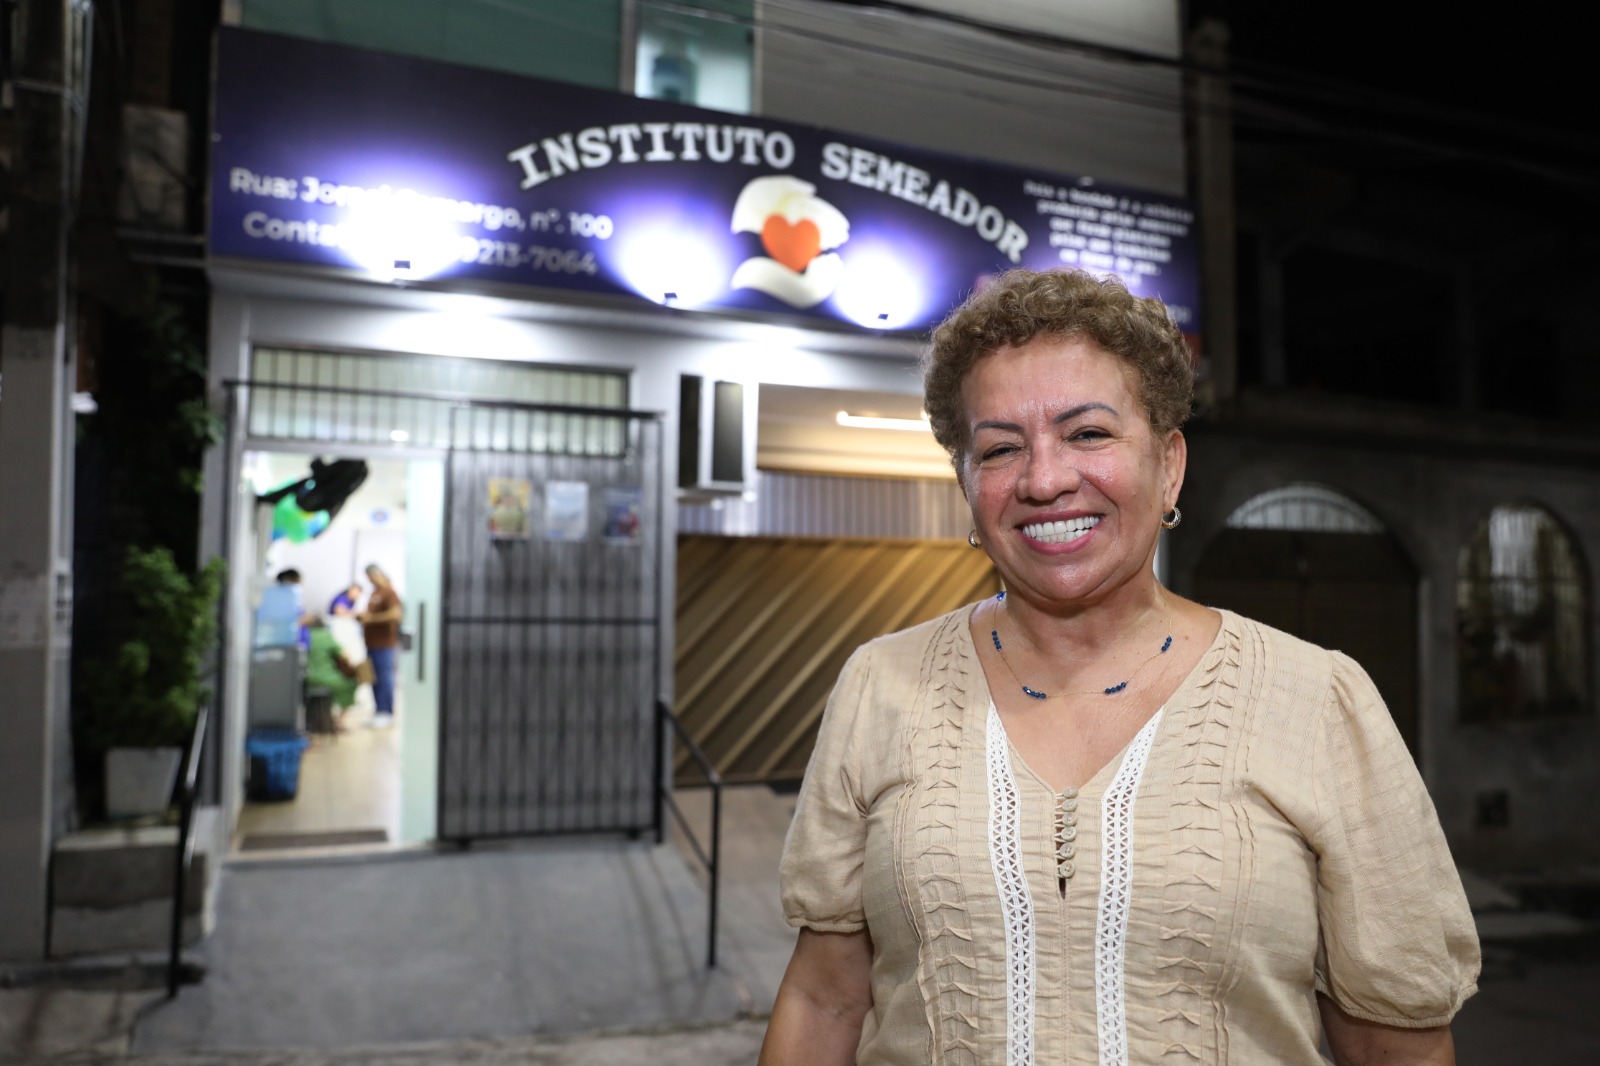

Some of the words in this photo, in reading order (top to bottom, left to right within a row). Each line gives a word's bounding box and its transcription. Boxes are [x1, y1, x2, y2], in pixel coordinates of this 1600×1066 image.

[230, 167, 298, 200] Rua:
[568, 211, 614, 240] 100
[508, 122, 794, 190] INSTITUTO
[821, 142, 1028, 262] SEMEADOR
